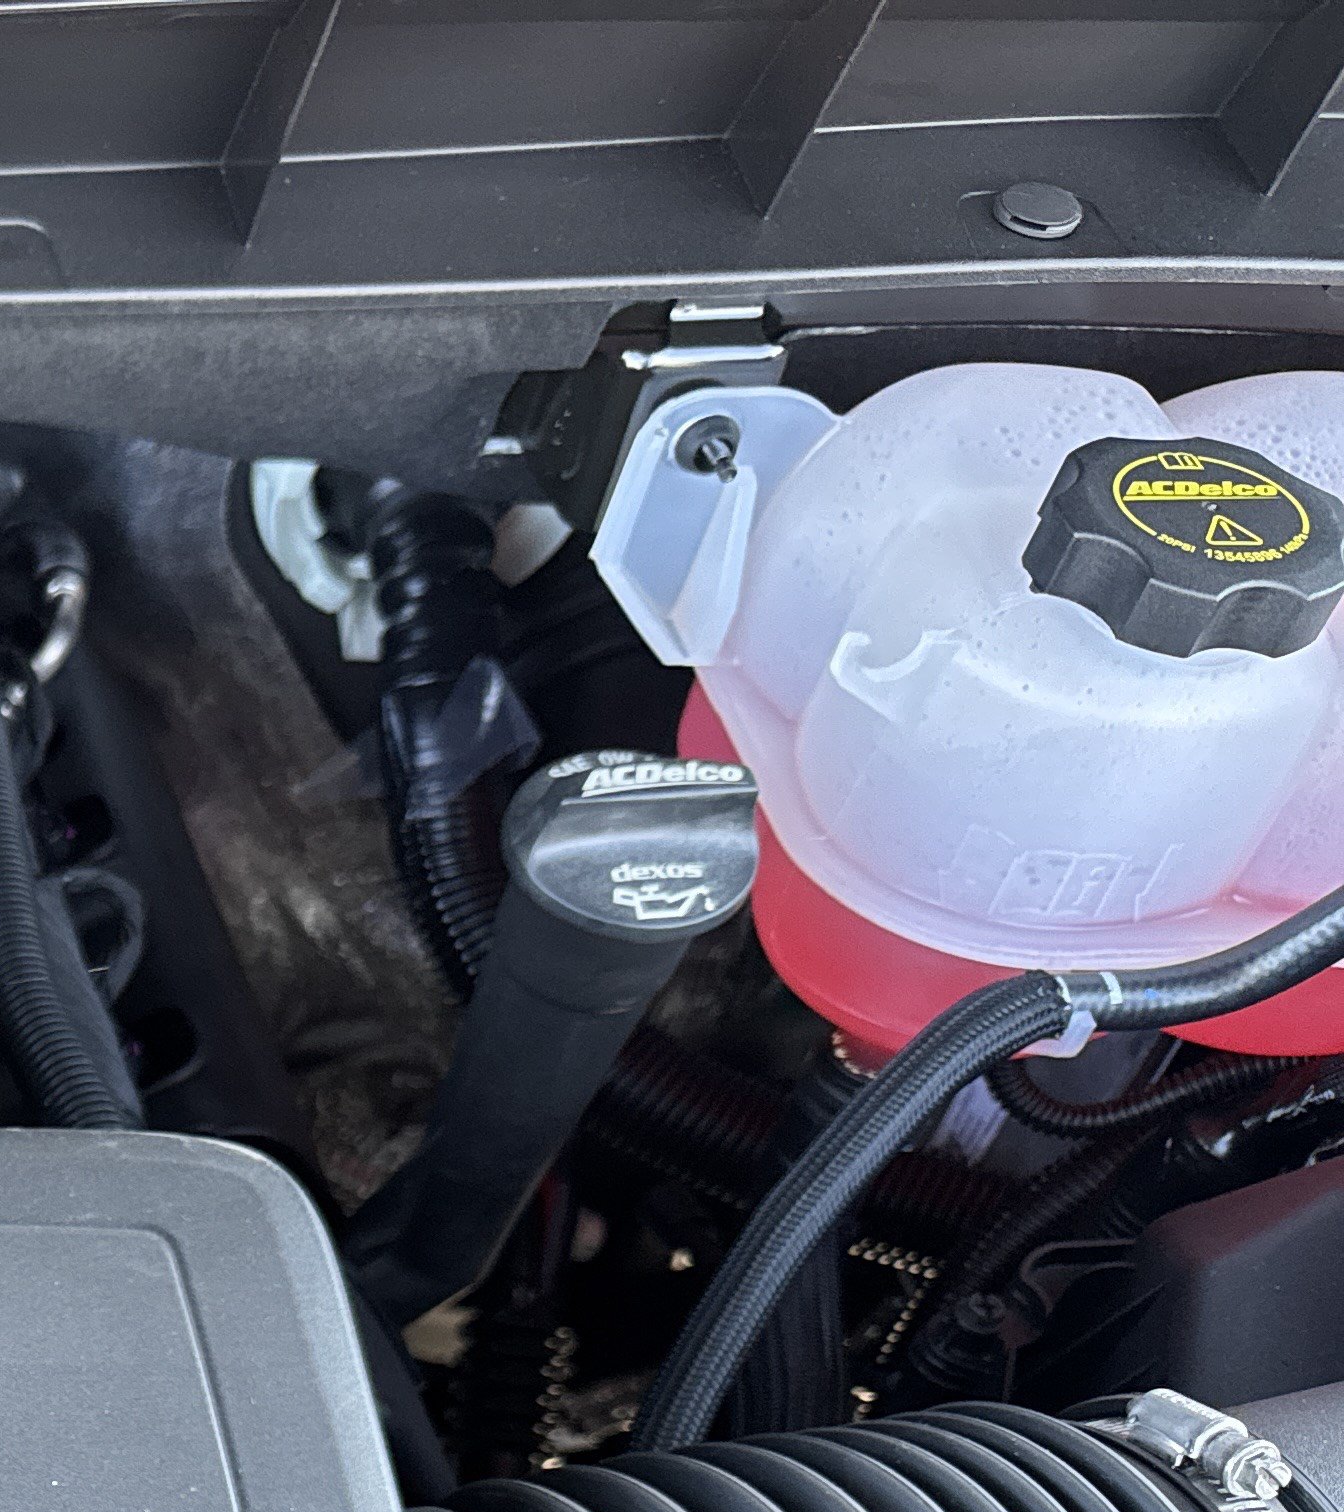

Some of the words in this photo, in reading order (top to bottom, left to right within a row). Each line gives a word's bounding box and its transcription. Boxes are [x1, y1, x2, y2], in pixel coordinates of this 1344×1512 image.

[1125, 480, 1279, 496] ACDelco
[581, 760, 744, 791] ACDelco
[611, 863, 704, 883] dexos
